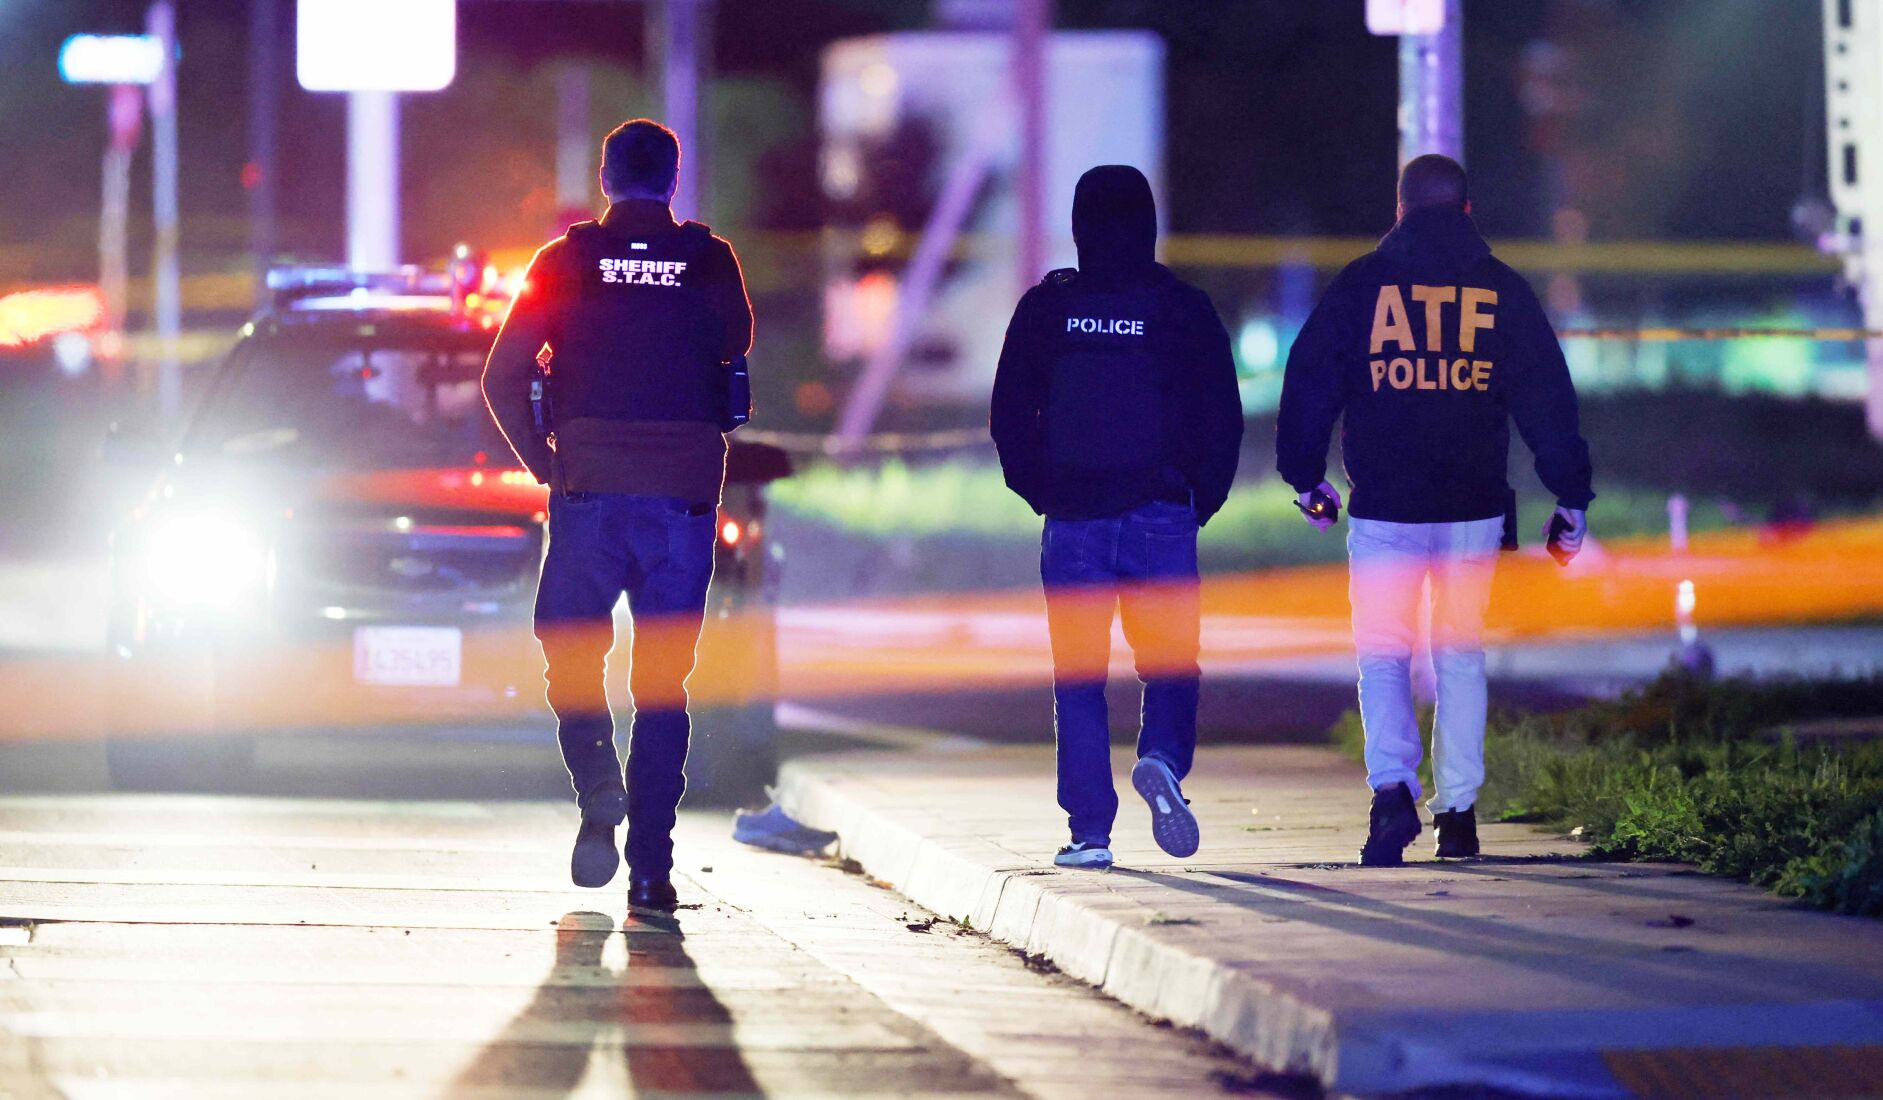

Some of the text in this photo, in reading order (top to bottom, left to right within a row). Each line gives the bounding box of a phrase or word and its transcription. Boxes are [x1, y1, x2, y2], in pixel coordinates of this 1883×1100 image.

[599, 258, 687, 274] SHERIFF
[602, 271, 681, 286] S.T.A.C.
[1066, 318, 1144, 335] POLICE
[1369, 284, 1498, 354] ATF
[1369, 357, 1493, 392] POLICE
